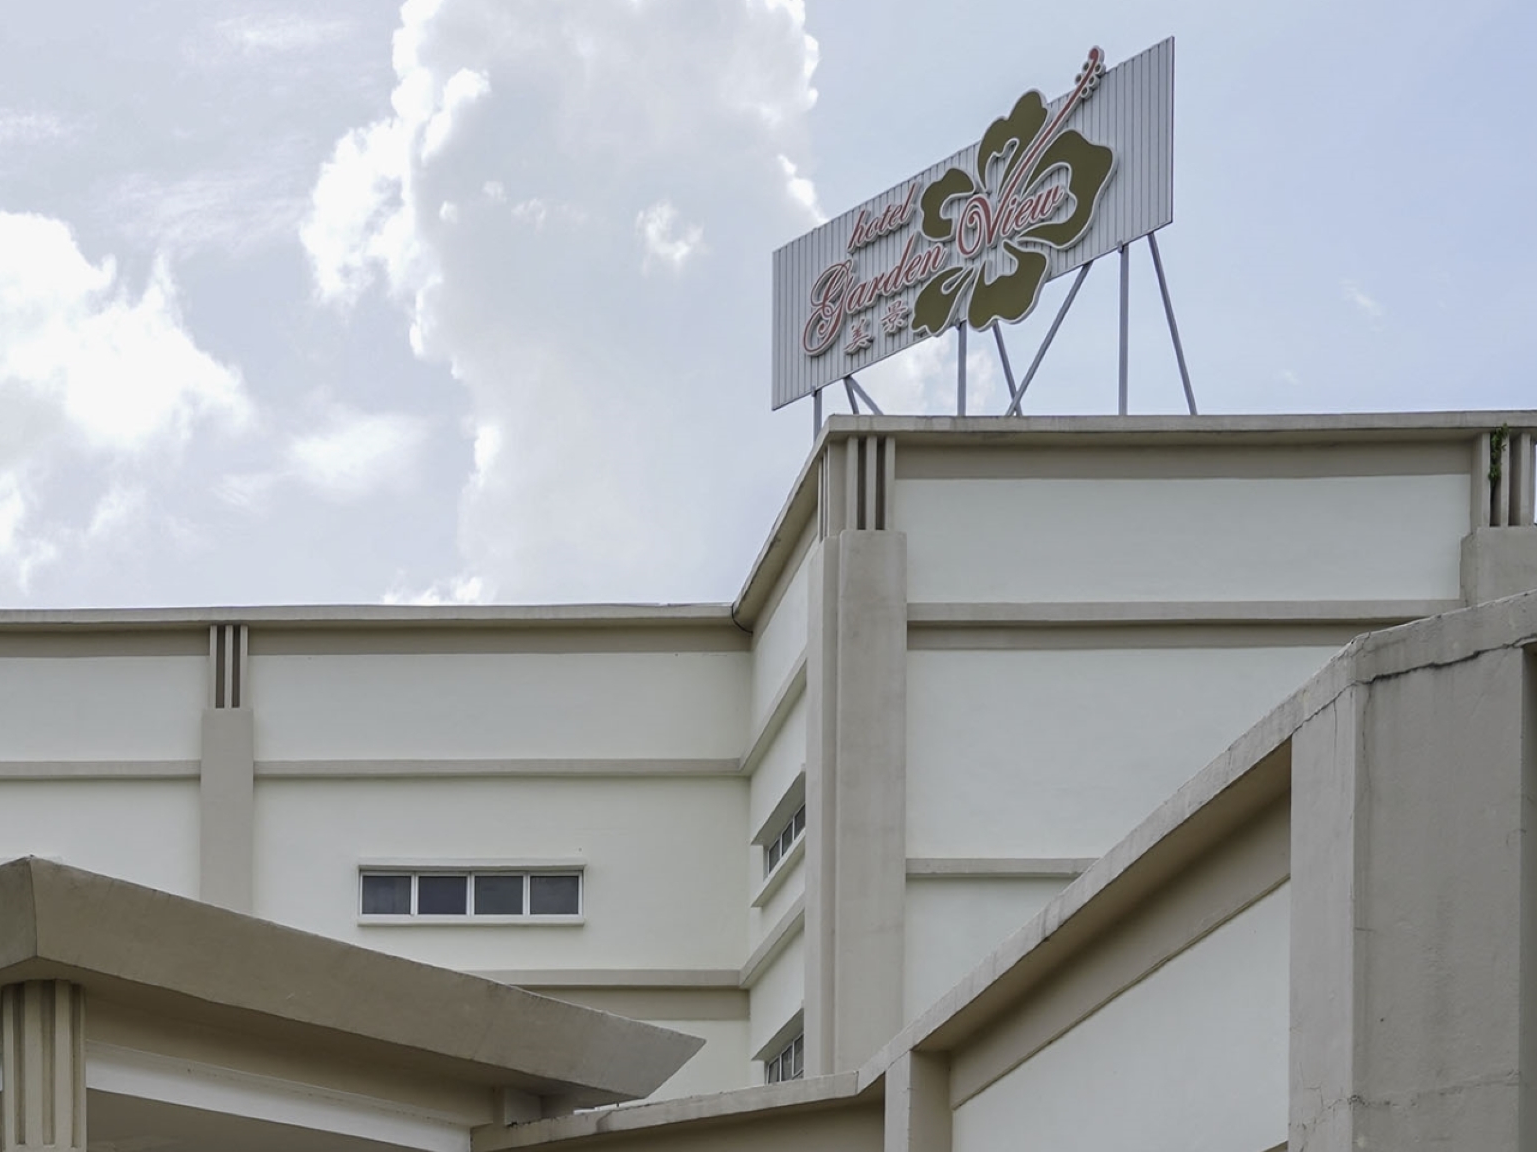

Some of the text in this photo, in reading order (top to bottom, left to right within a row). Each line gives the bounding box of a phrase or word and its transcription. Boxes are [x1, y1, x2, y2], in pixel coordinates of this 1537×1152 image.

[848, 182, 918, 251] hotel
[803, 184, 1060, 353] Garden View
[845, 299, 911, 354] 美景
